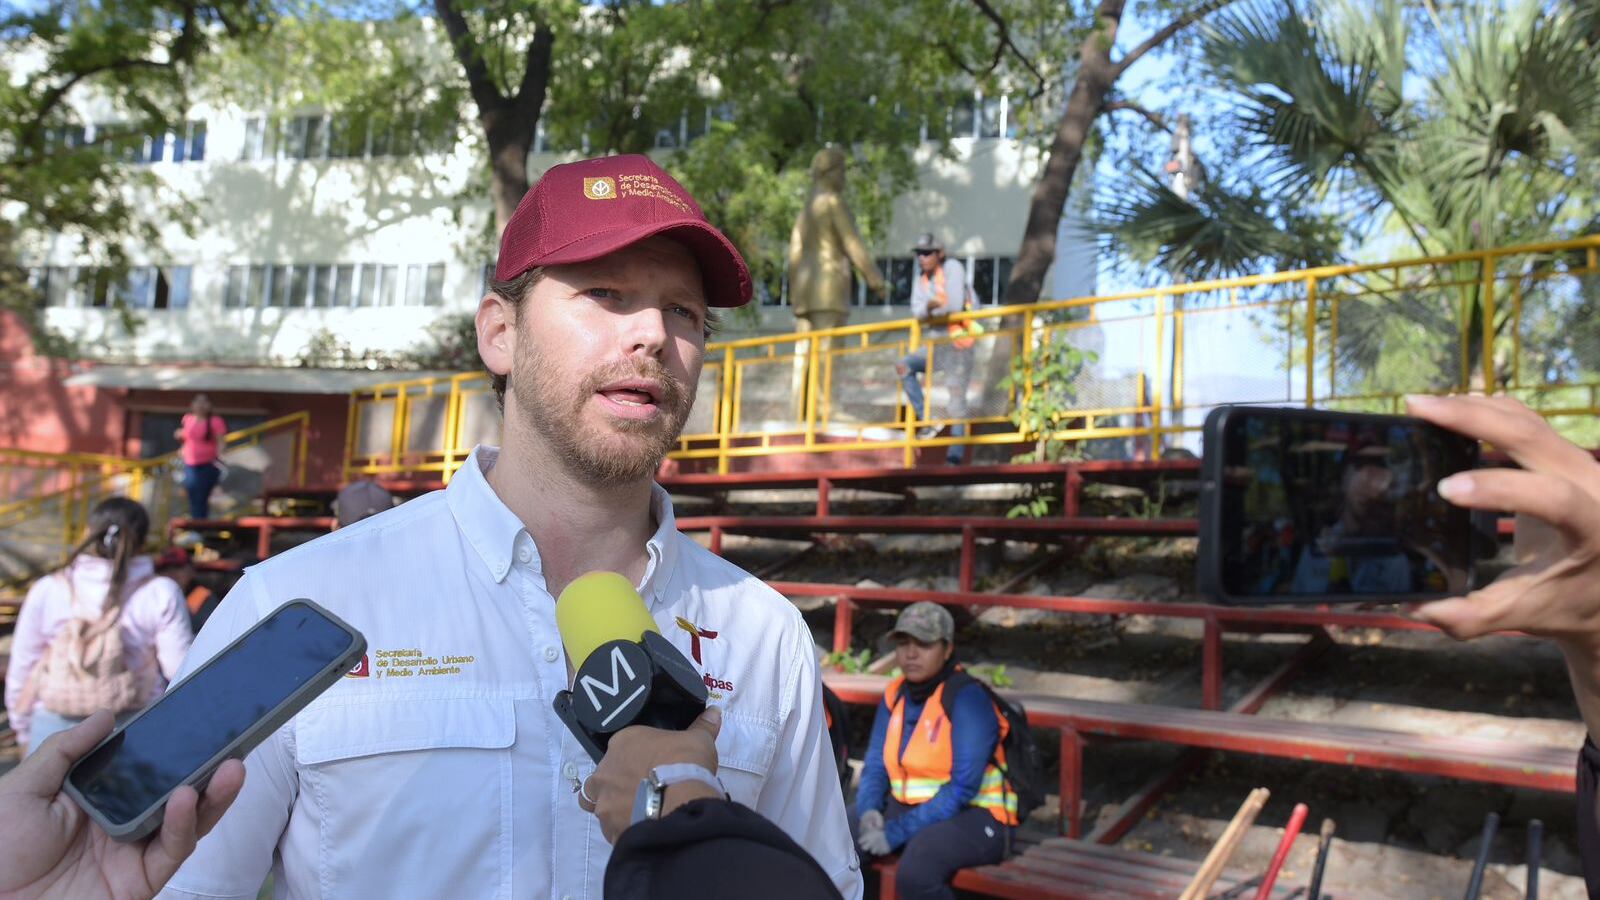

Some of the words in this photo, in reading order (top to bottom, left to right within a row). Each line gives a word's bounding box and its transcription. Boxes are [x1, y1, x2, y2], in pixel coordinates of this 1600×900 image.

[621, 182, 631, 190] de
[629, 189, 655, 198] Medio
[376, 659, 389, 667] de
[392, 656, 439, 667] Desarrollo
[441, 655, 475, 665] Urbano
[376, 670, 383, 678] y
[386, 667, 414, 676] Medio
[417, 665, 461, 676] Ambiente
